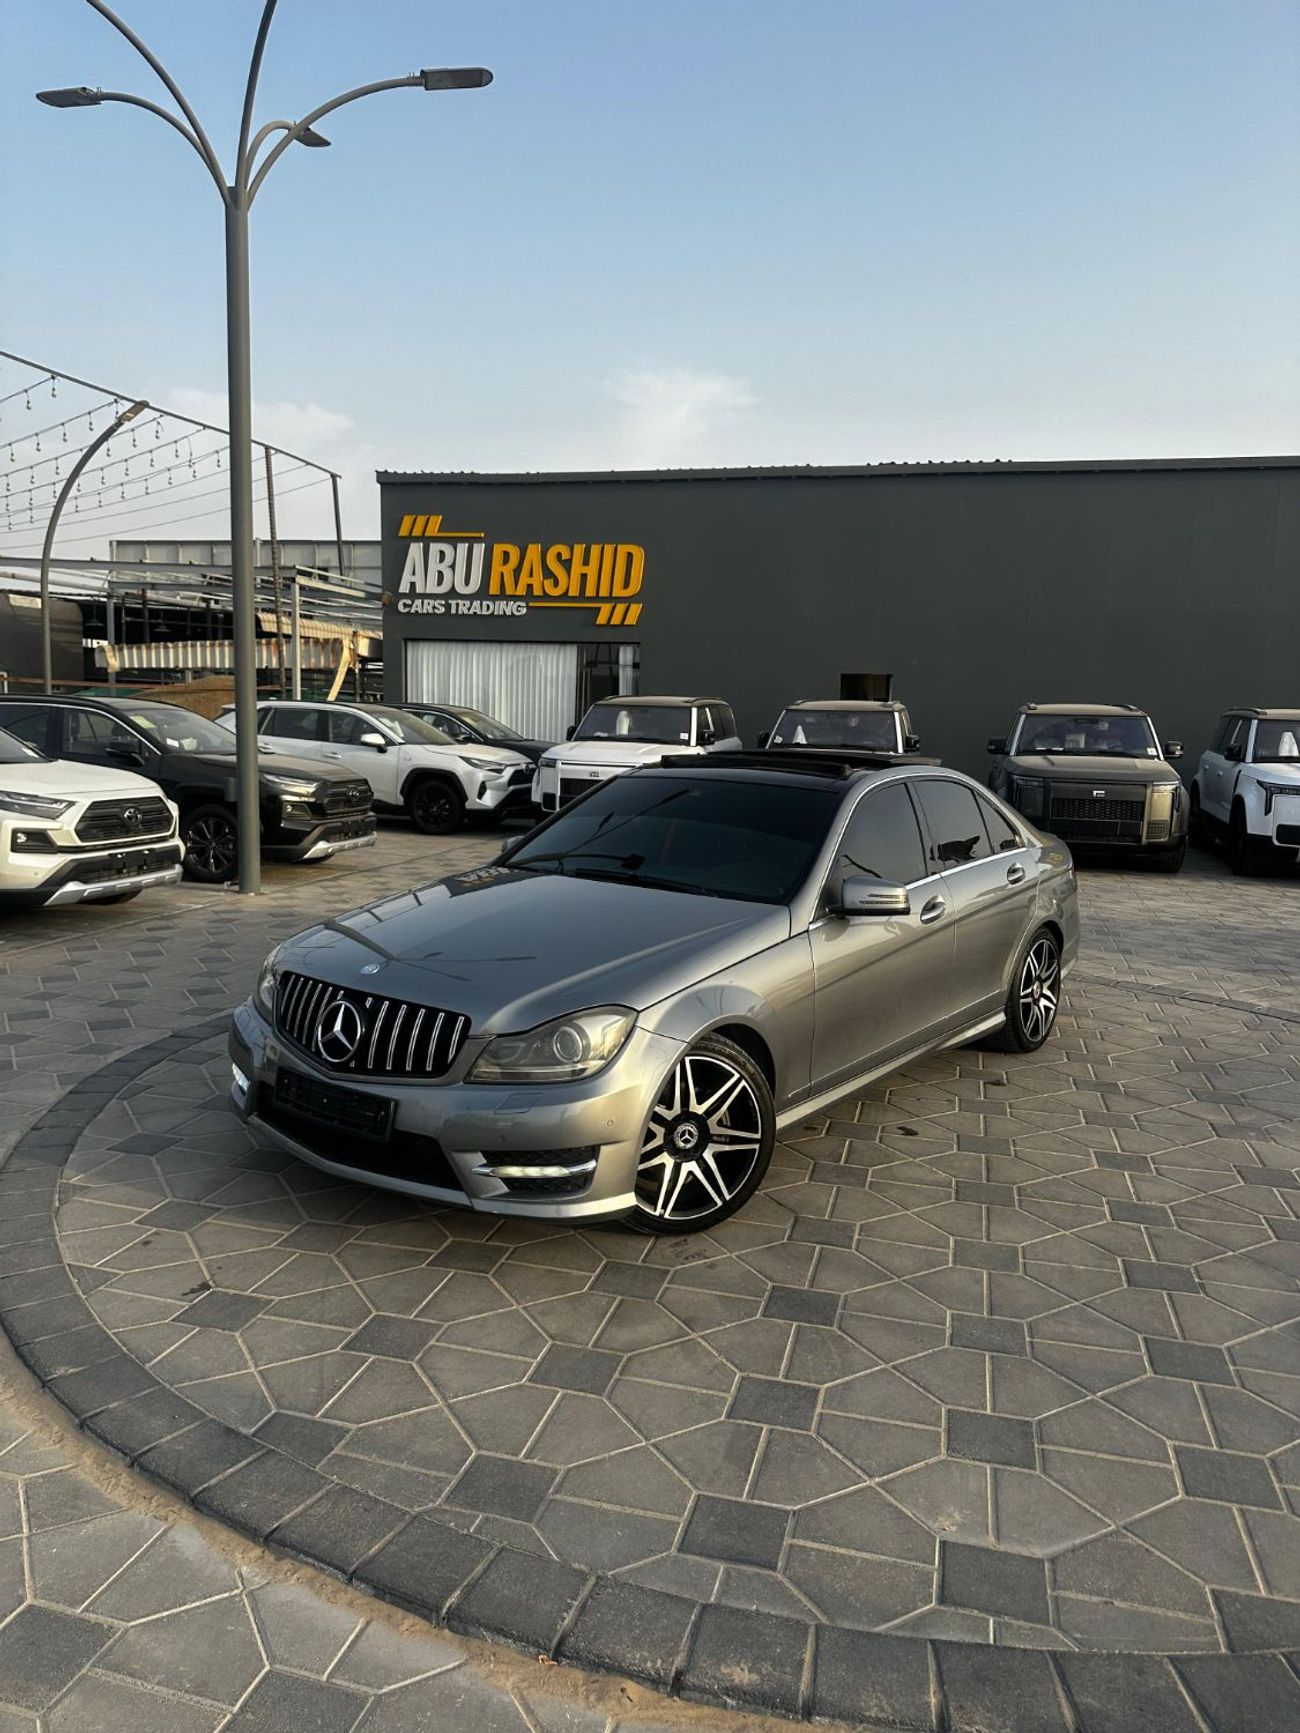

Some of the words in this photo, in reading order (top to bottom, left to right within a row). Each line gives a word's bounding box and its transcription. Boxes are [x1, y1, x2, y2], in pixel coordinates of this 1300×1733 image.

[398, 542, 485, 594] ABU
[488, 543, 645, 597] RASHID
[398, 599, 445, 614] CARS
[449, 600, 527, 616] TRADING
